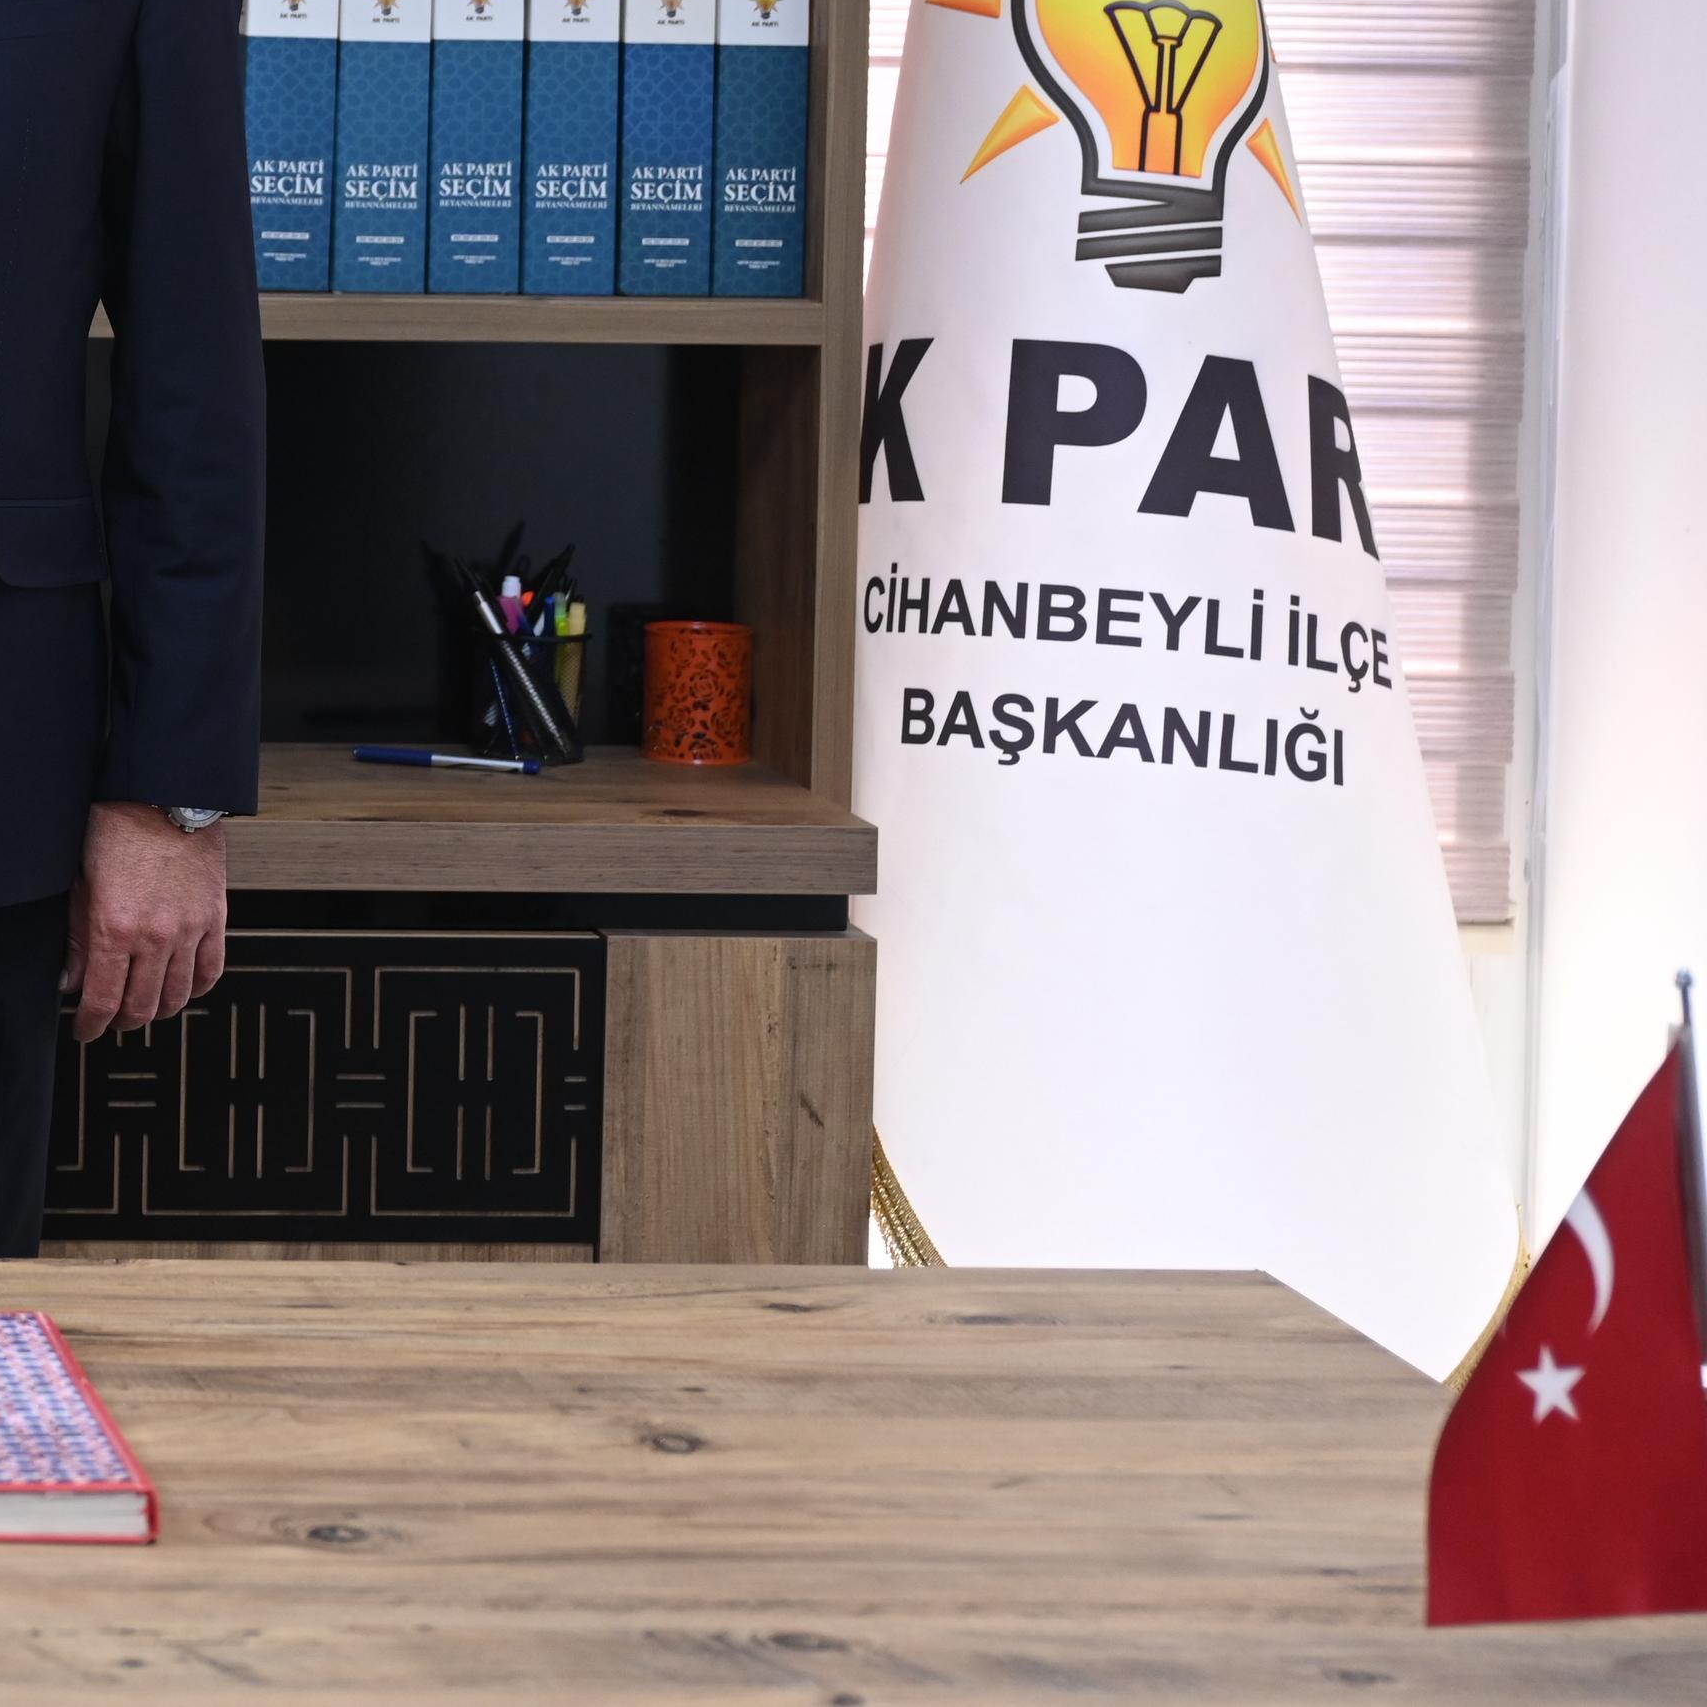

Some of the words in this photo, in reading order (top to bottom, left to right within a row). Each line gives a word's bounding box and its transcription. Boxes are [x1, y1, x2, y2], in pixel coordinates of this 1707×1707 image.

[252, 160, 275, 173] AK
[278, 159, 324, 174] PARTİ
[347, 164, 369, 178] AK
[372, 163, 418, 178] PARTİ
[441, 162, 463, 176] AK
[466, 161, 512, 177] PARTİ
[537, 164, 559, 177] AK
[562, 162, 608, 178] PARTİ
[631, 166, 654, 180] AK
[657, 165, 703, 180] PARTİ
[725, 168, 748, 181] AK
[751, 166, 796, 182] PARTİ
[250, 174, 323, 197] SEÇİM
[345, 178, 417, 201] SEÇİM
[439, 176, 512, 200] SEÇİM
[535, 178, 608, 201] SEÇİM
[630, 180, 703, 203] SEÇİM
[724, 181, 796, 205] SEÇİM
[863, 562, 1265, 662] CİHANBEYLİ
[1287, 595, 1393, 694] İLÇE
[900, 687, 1345, 787] BAŞKANLIĞI
